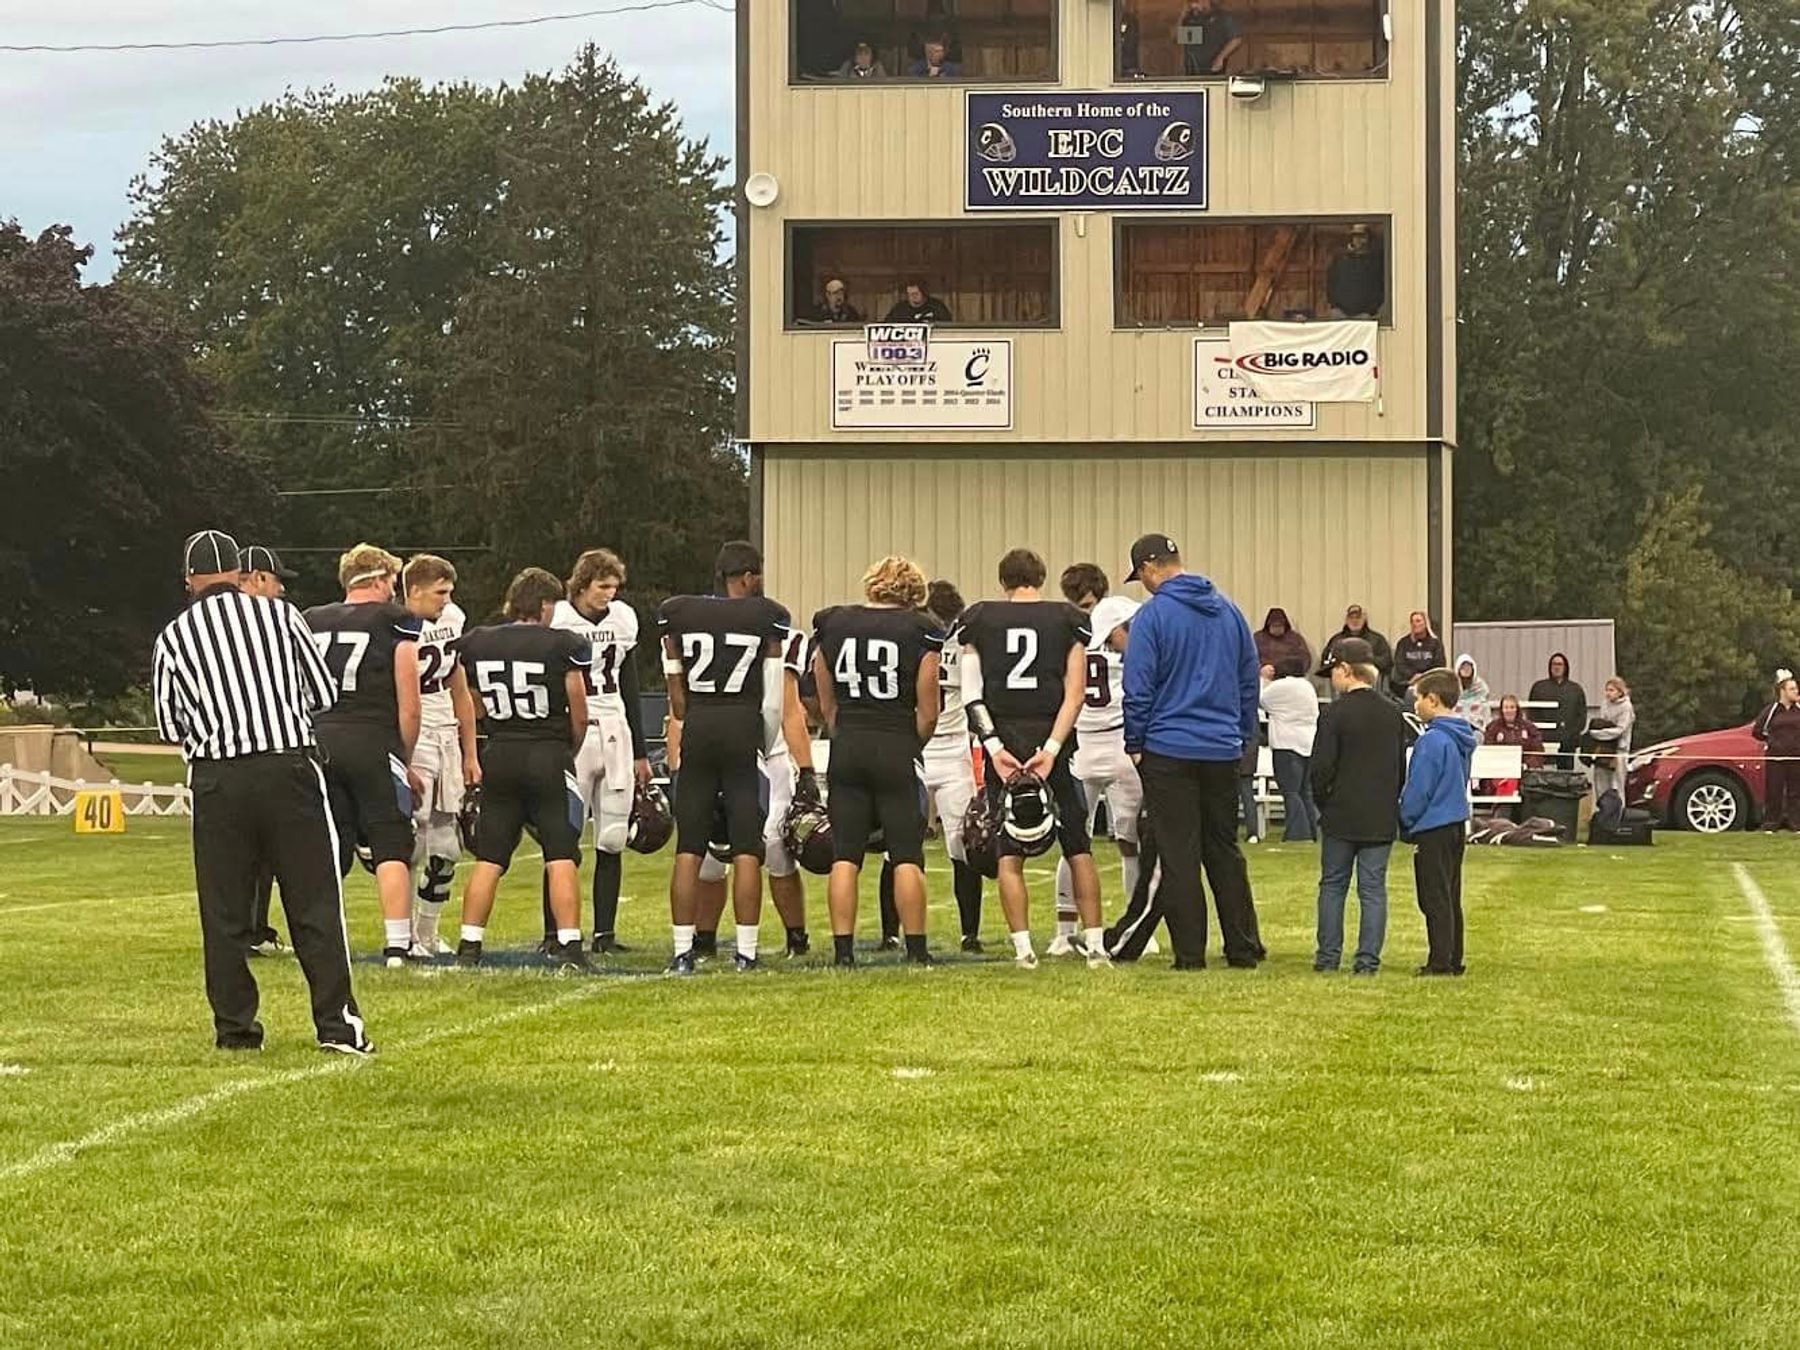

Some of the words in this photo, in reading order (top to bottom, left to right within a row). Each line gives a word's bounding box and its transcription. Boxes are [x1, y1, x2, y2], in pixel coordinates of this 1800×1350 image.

[1002, 103, 1072, 118] Southern
[1077, 103, 1122, 118] Home
[1126, 102, 1144, 117] of
[1146, 103, 1171, 117] the
[1048, 128, 1124, 158] EPC
[983, 166, 1190, 196] WILDCATZ
[870, 327, 924, 341] WCCI
[1264, 352, 1299, 367] BIG
[1302, 349, 1368, 367] RADIO
[856, 374, 936, 386] PLAYOFFS
[1205, 405, 1303, 417] CHAMPIONS
[681, 632, 762, 693] 27
[834, 637, 899, 700] 43
[1006, 627, 1039, 690] 2
[475, 660, 550, 720] 55
[1085, 654, 1111, 708] 9
[84, 795, 112, 829] 40
